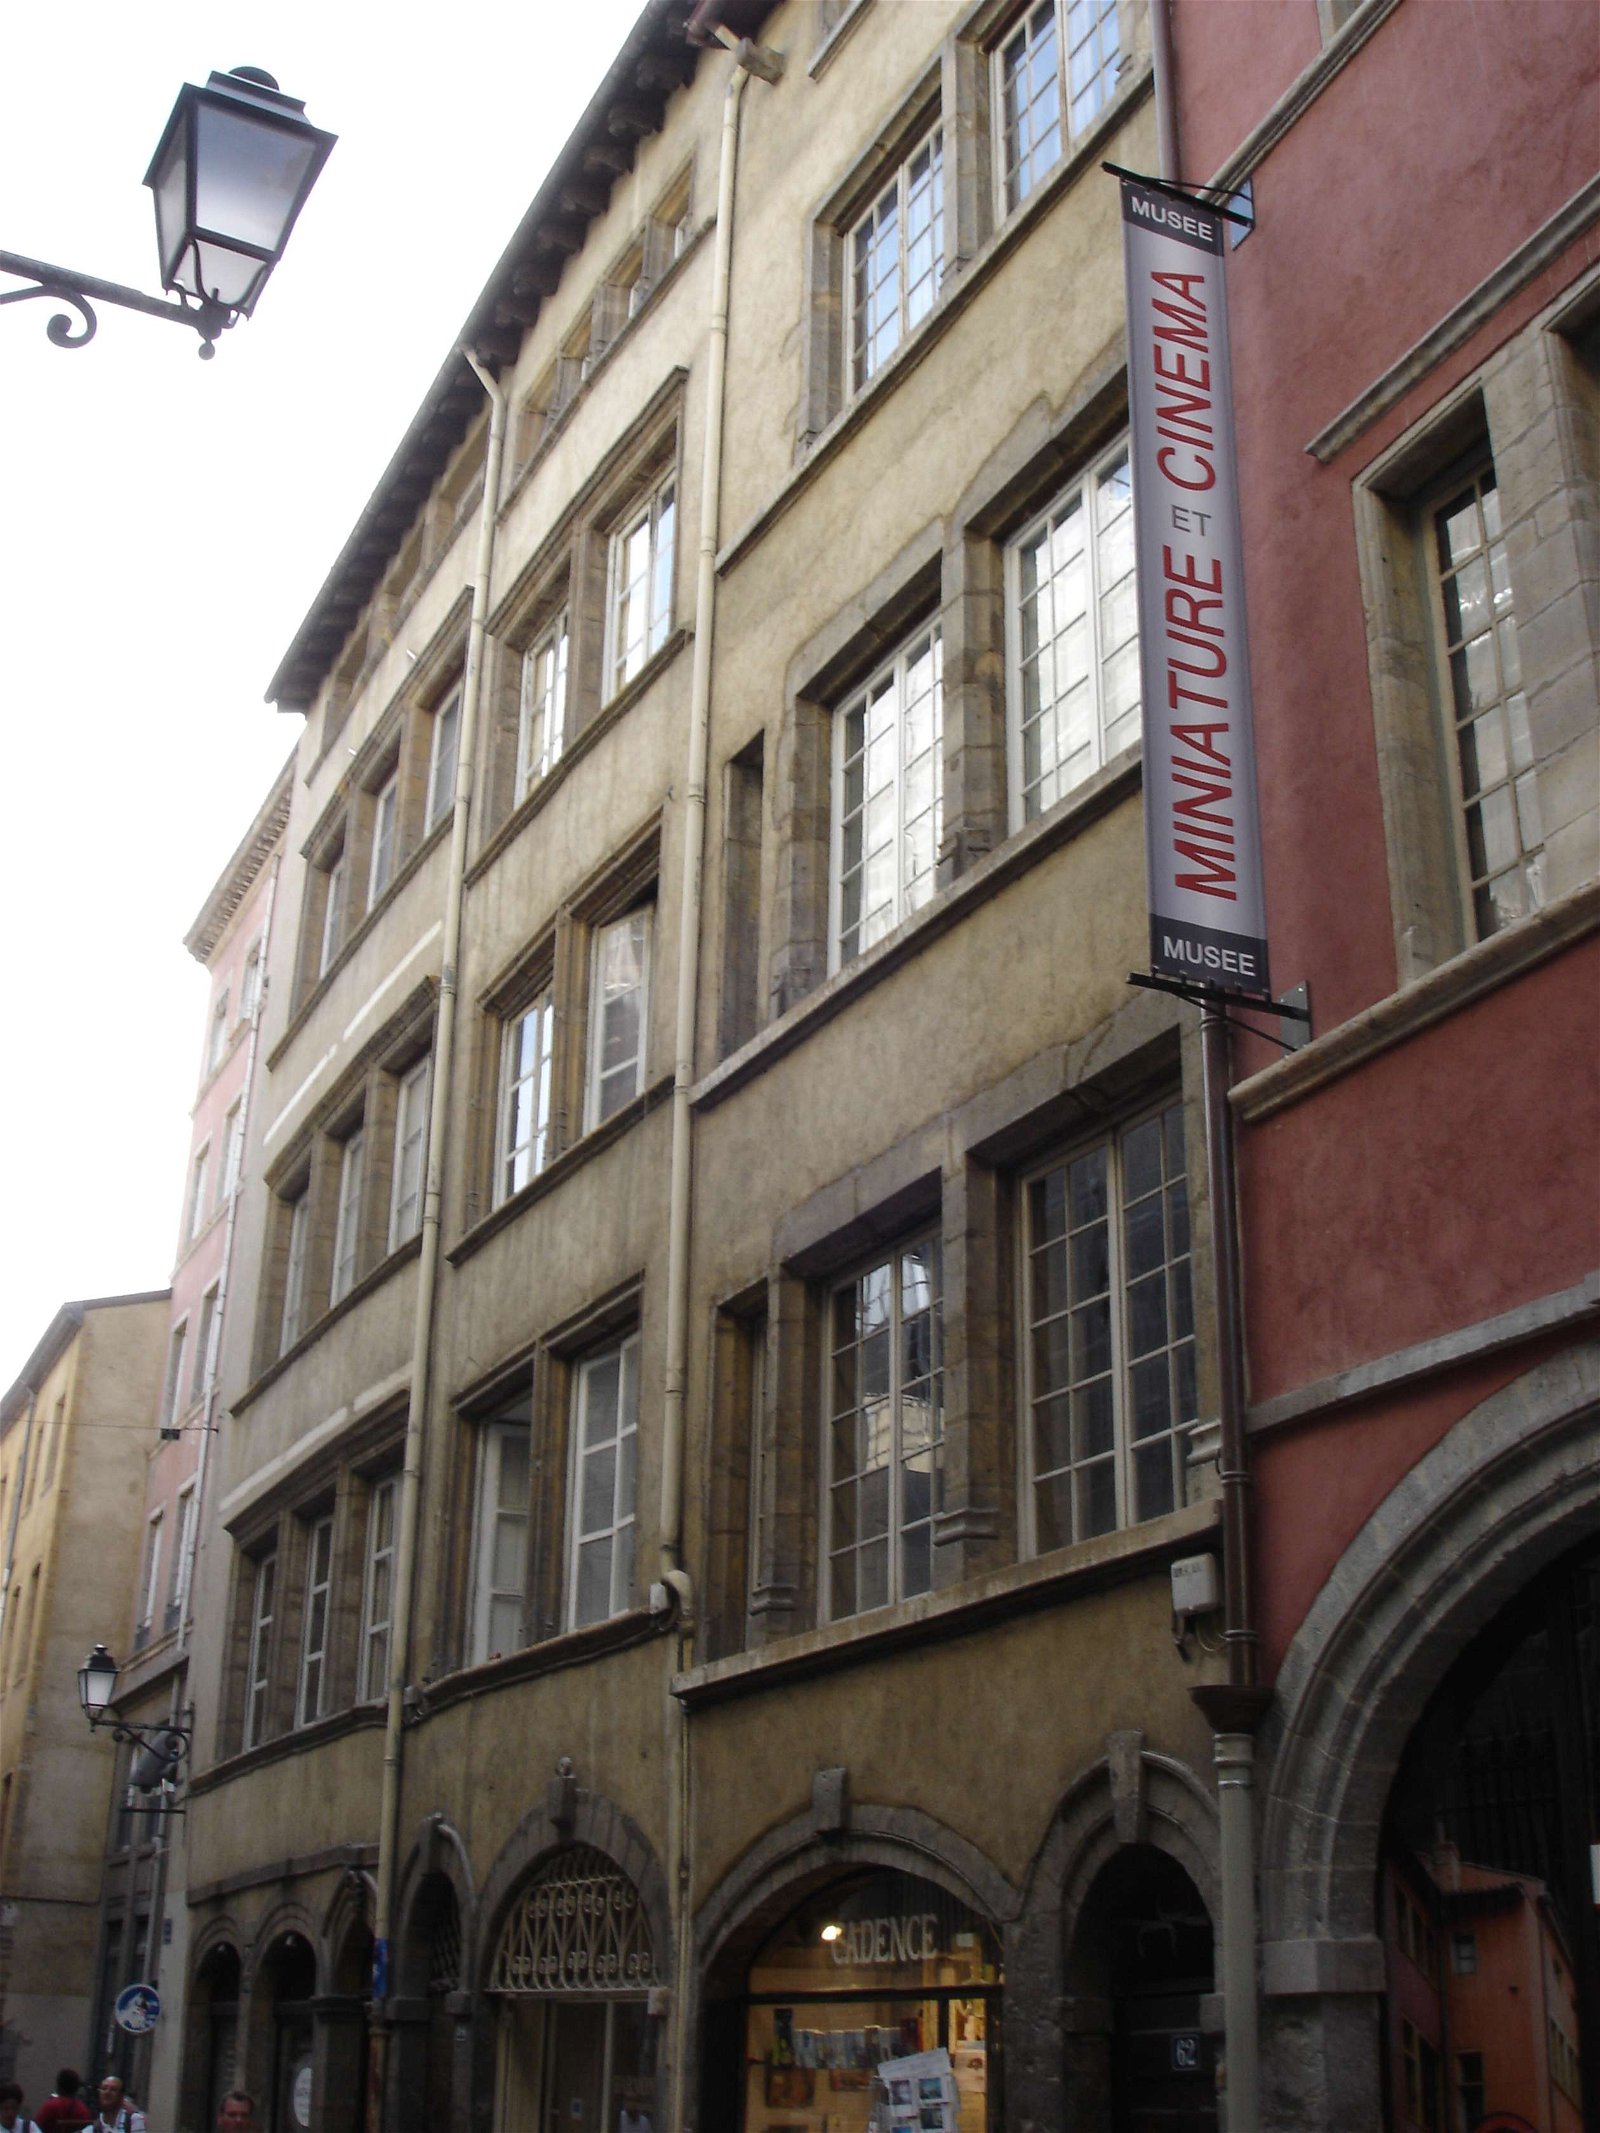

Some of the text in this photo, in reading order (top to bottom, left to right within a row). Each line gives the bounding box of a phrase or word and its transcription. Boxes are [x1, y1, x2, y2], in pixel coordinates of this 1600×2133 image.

[1131, 195, 1214, 243] MUSEE
[1150, 271, 1238, 901] MINIATURE ET CINEMA
[1163, 935, 1256, 977] MUSEE
[1176, 2038, 1197, 2065] 62
